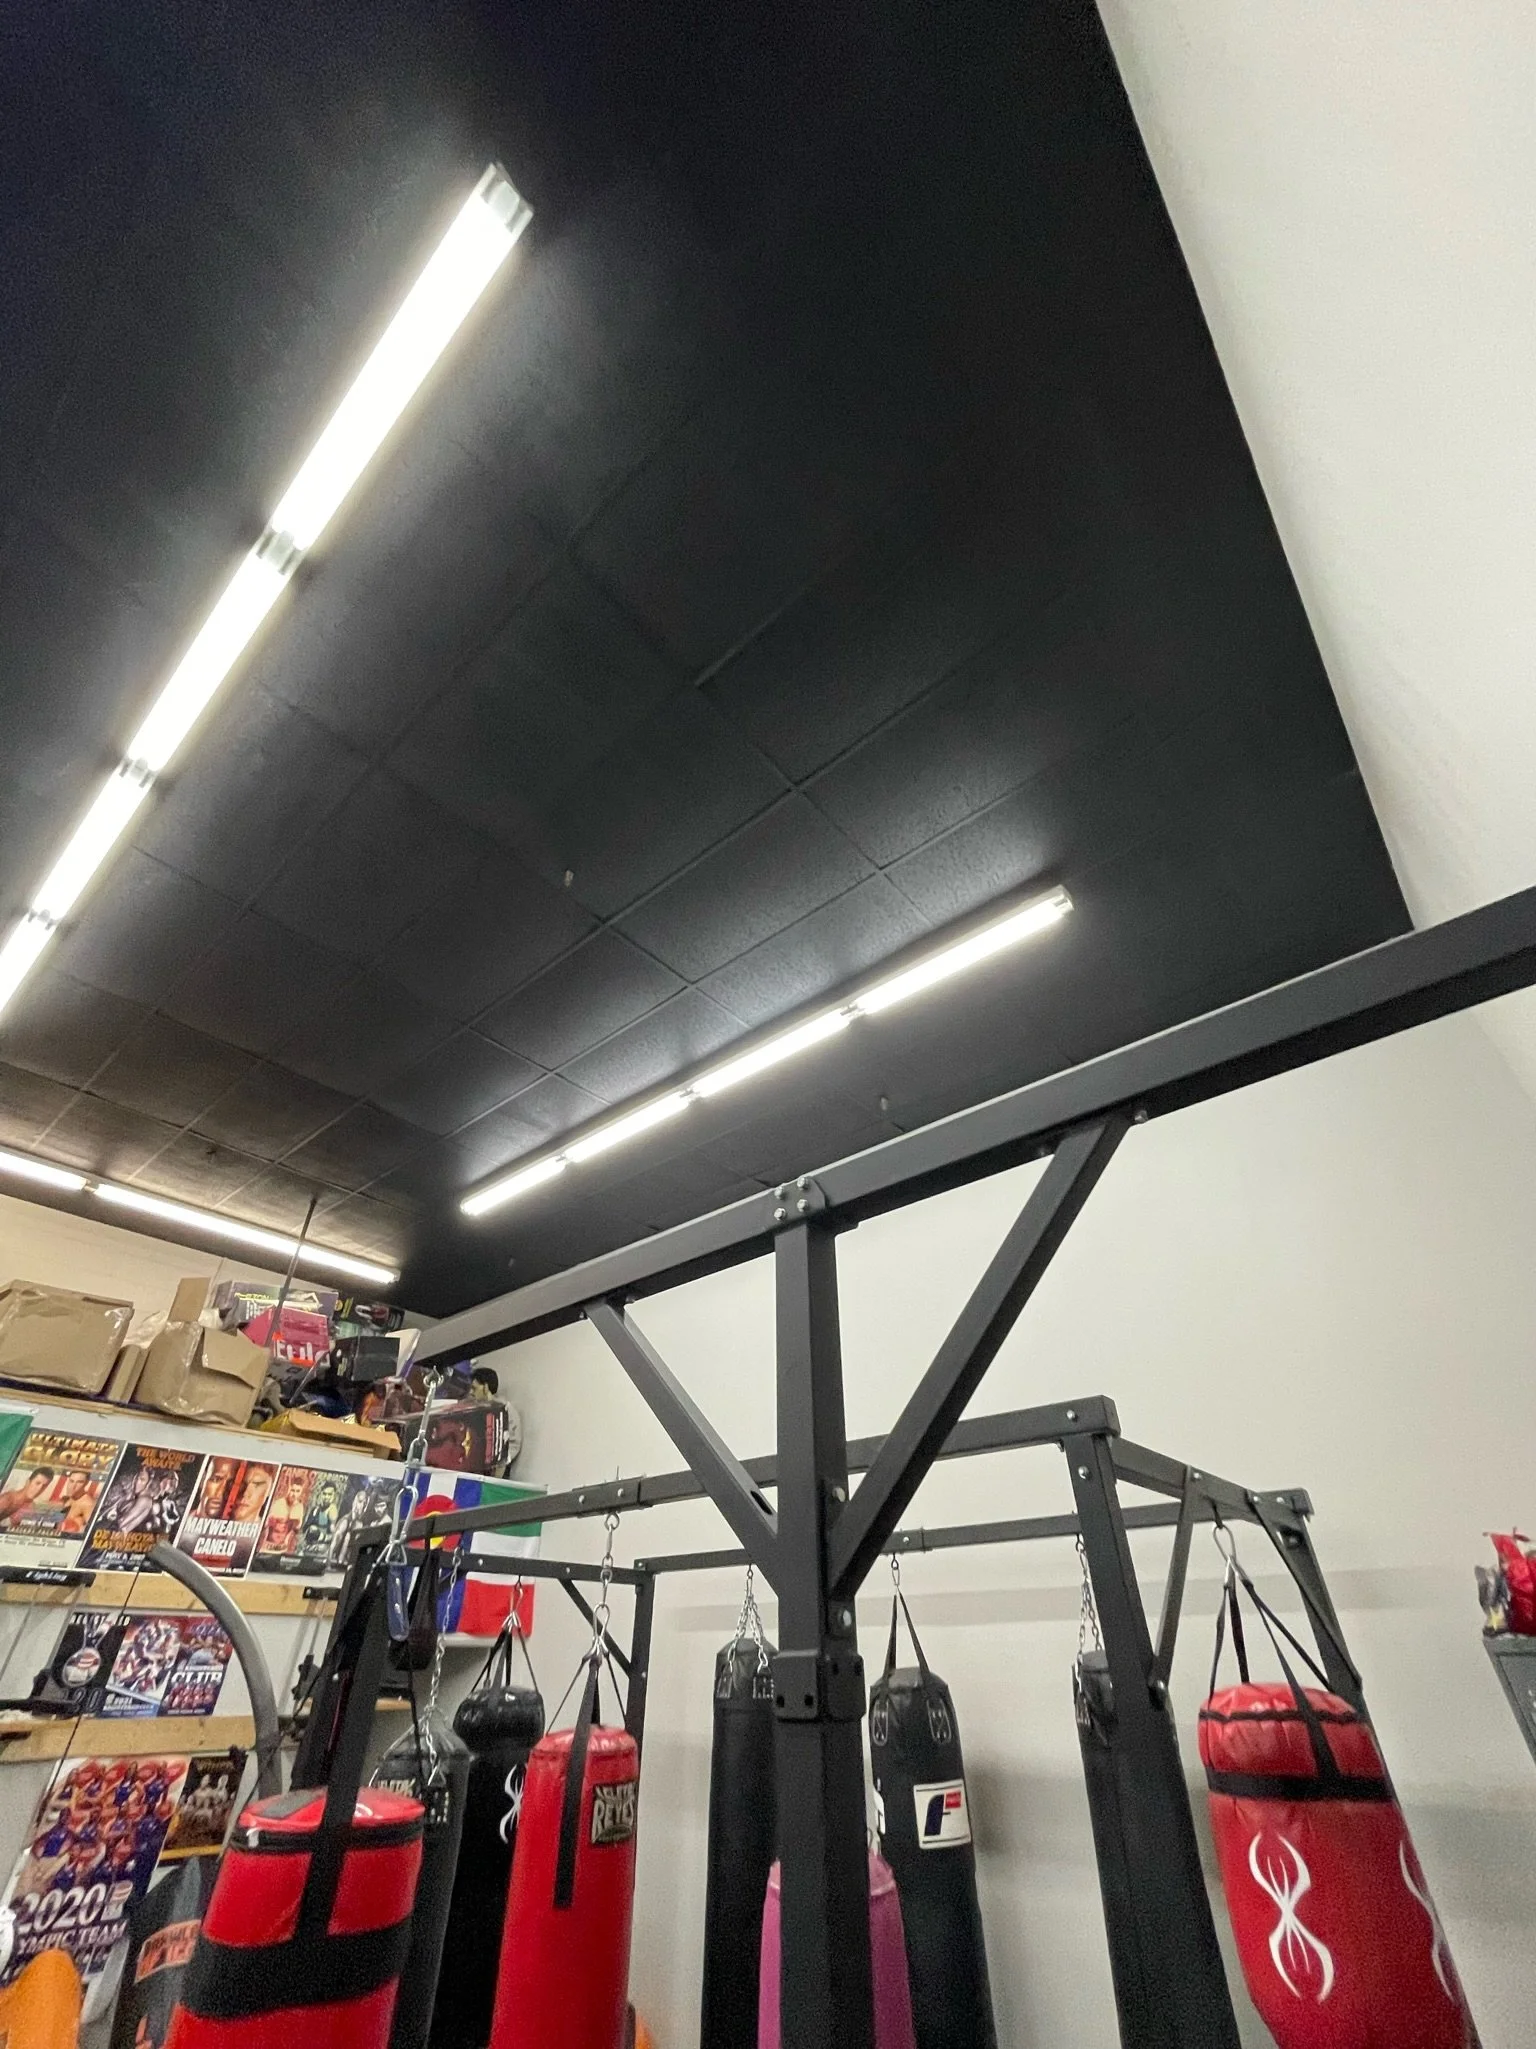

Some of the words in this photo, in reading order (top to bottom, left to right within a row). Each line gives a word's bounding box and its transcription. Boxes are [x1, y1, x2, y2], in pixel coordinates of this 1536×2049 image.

[183, 1515, 259, 1538] MAYWEATHER
[193, 1537, 237, 1557] CANELO
[170, 1670, 223, 1684] CLUB
[592, 1799, 634, 1843] REYES
[17, 1883, 107, 1934] 2020
[77, 1919, 128, 1947] TEAM
